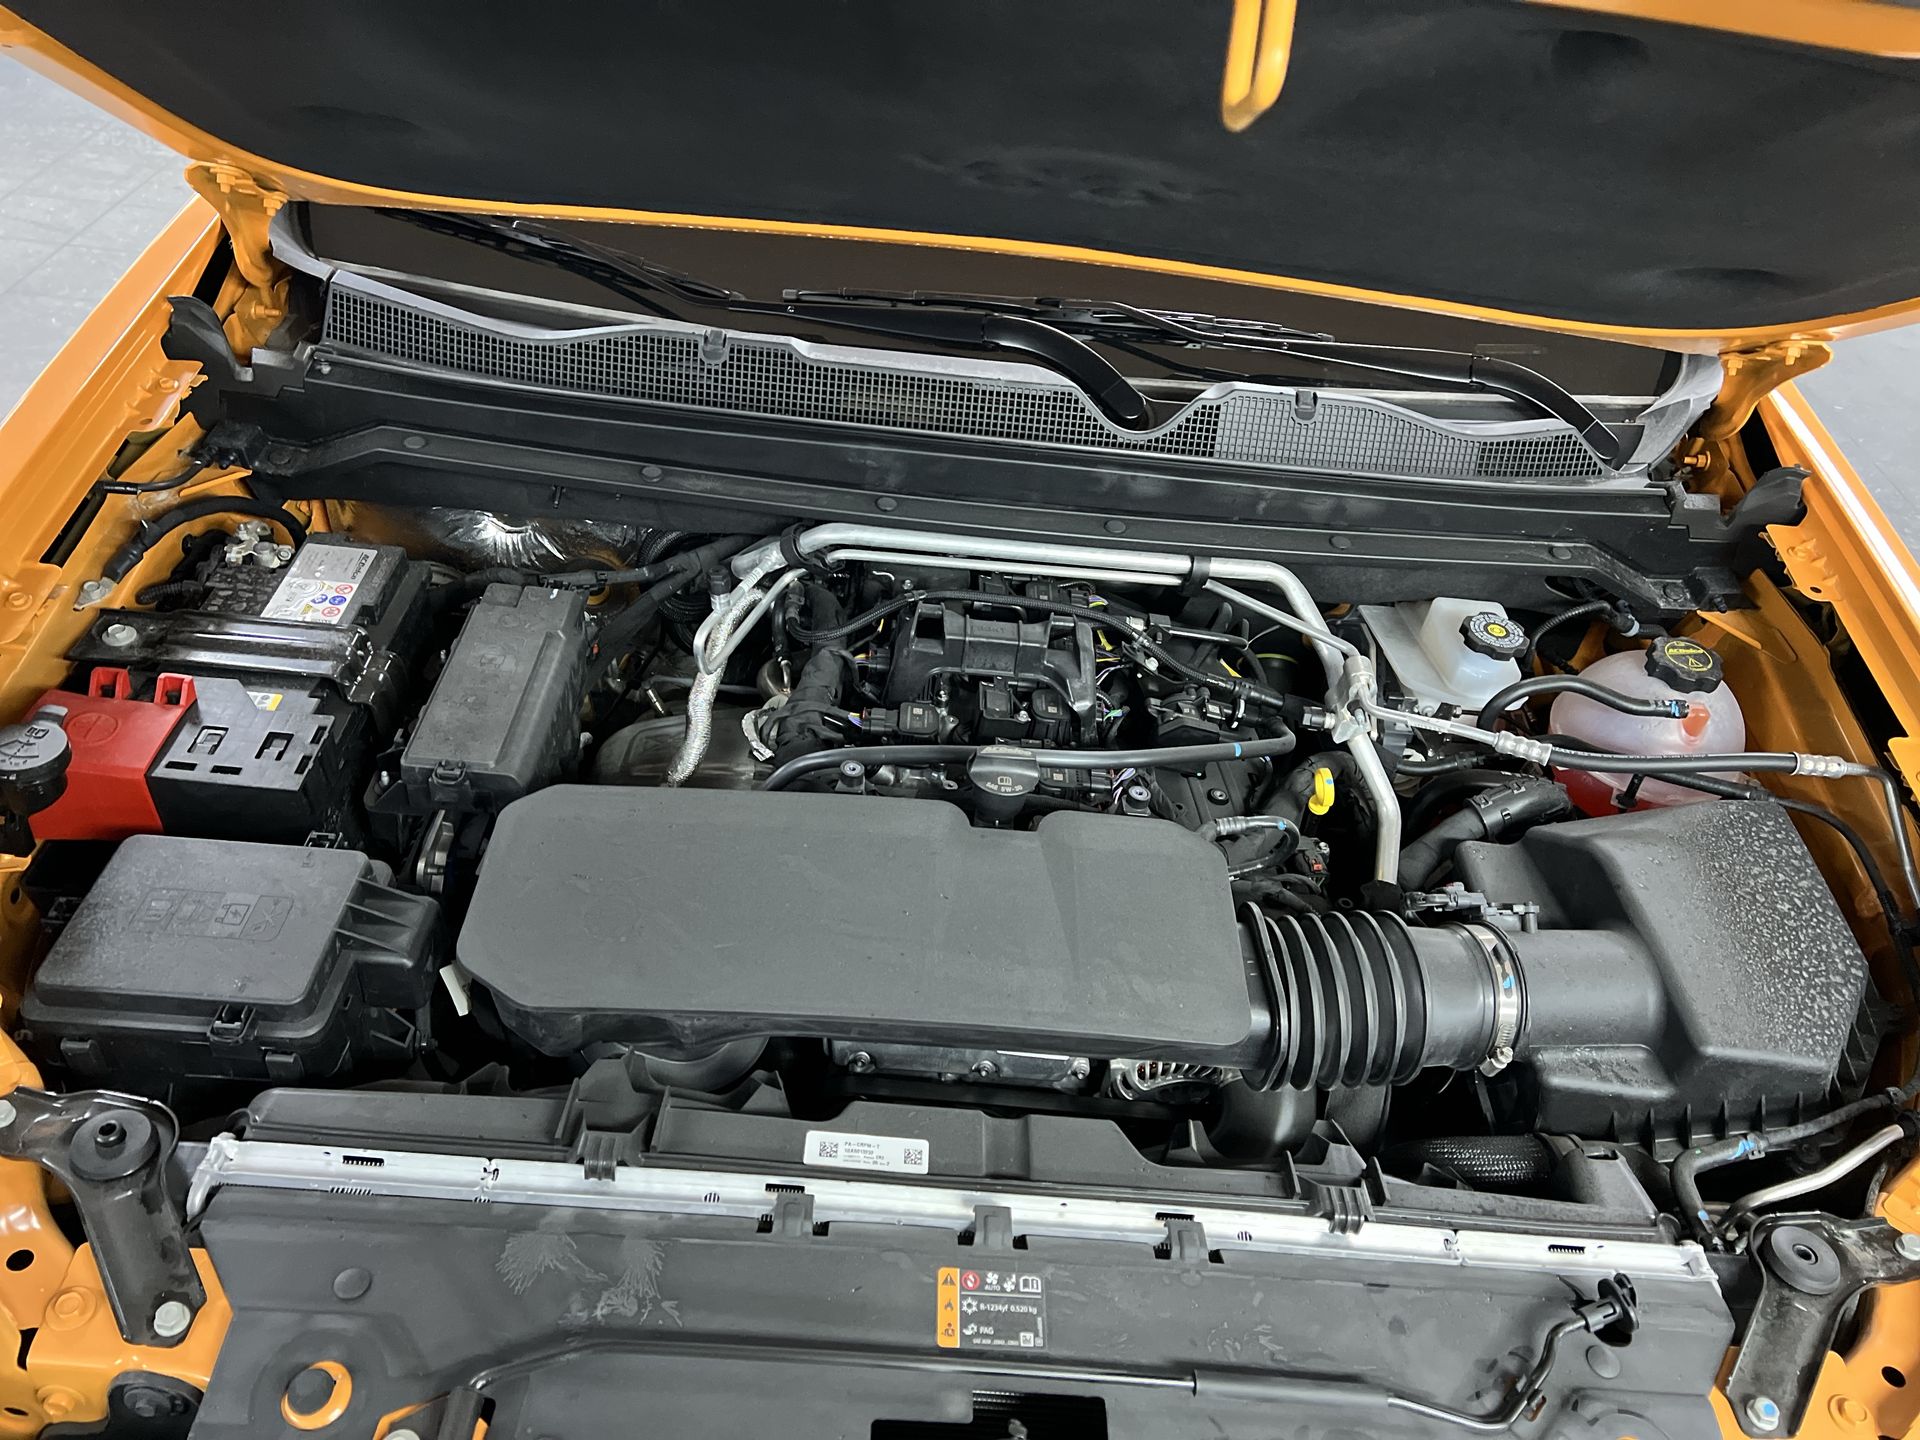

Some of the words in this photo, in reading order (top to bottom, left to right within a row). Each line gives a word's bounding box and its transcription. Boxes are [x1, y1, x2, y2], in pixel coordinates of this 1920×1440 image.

[980, 1303, 1009, 1314] R-1234yf
[1010, 1304, 1028, 1313] 0.520
[1028, 1304, 1038, 1315] kg
[979, 1326, 994, 1335] PAG
